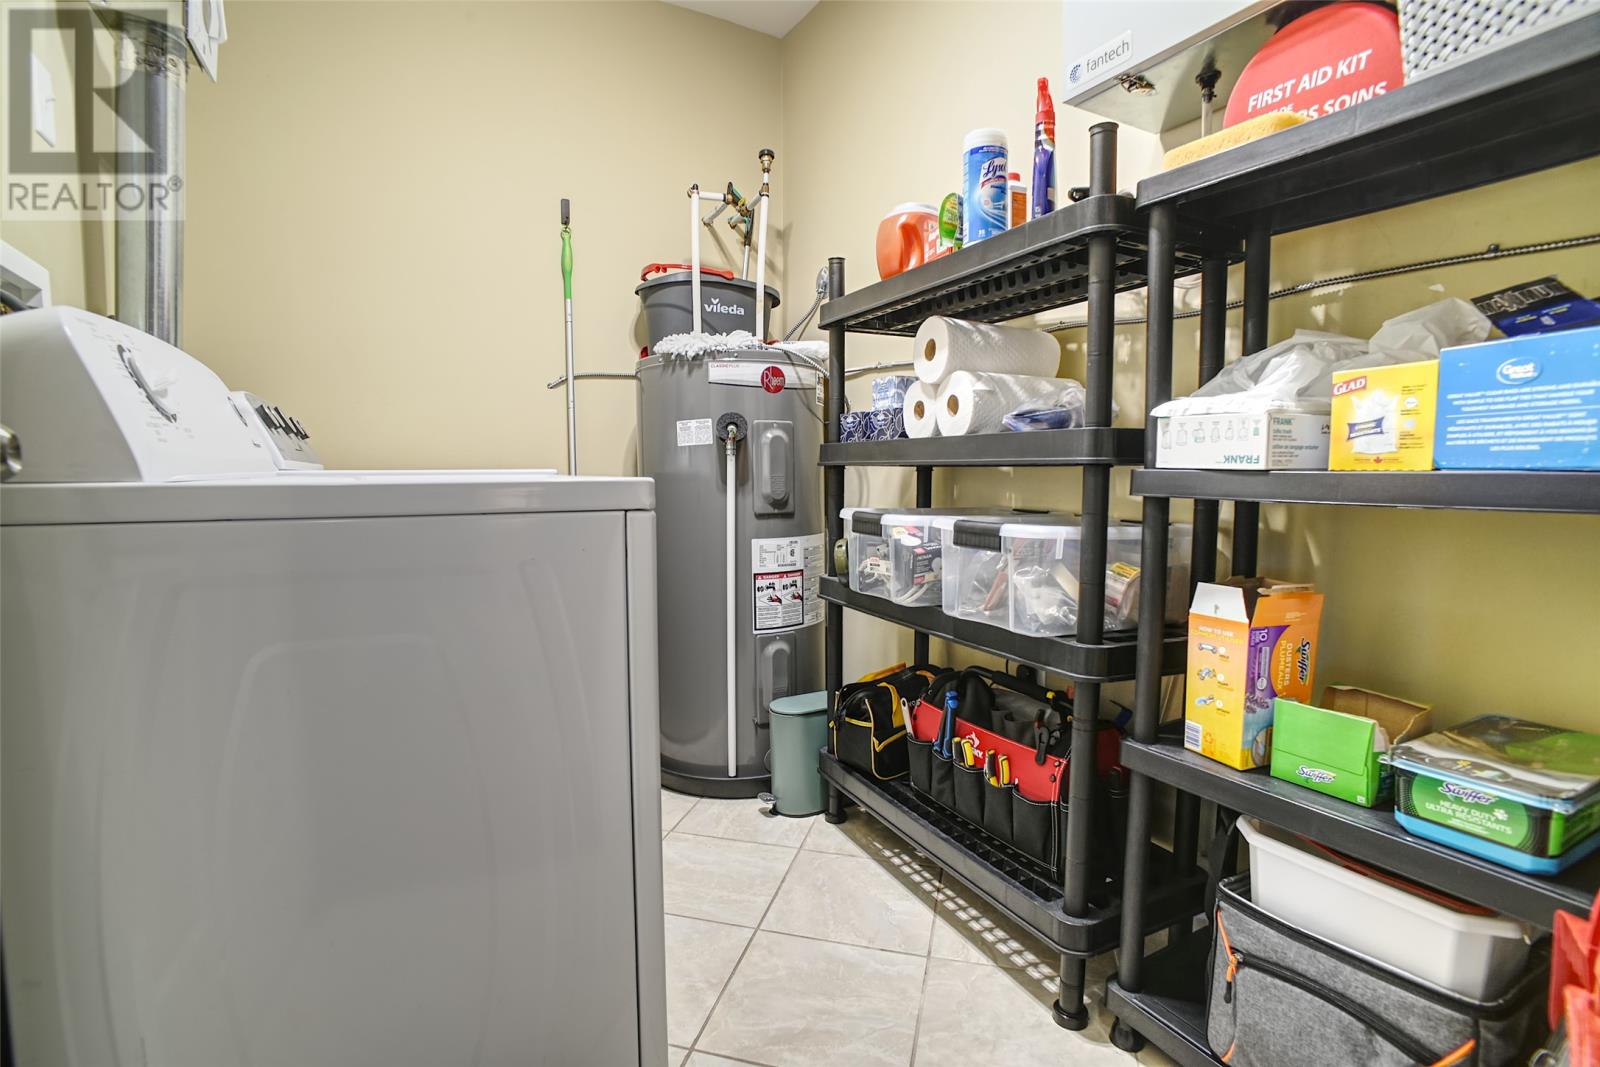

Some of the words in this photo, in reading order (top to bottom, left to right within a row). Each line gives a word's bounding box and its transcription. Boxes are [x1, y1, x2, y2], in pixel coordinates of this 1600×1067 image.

[1086, 39, 1130, 73] fantech
[1247, 79, 1297, 113] FIRST
[1296, 65, 1333, 94] AID
[1335, 48, 1373, 79] KIT
[1322, 81, 1388, 116] SOINS
[704, 297, 745, 316] vileda
[1333, 378, 1366, 395] GLAD
[1223, 454, 1260, 465] FRANK
[1284, 642, 1294, 686] DUSTERS
[1296, 637, 1311, 682] Swiffer
[1297, 764, 1335, 783] Swiffer
[1439, 781, 1493, 804] Swiffer
[1425, 802, 1454, 816] ULTRA
[1439, 800, 1469, 814] HEAVY
[1471, 808, 1497, 821] DUTY
